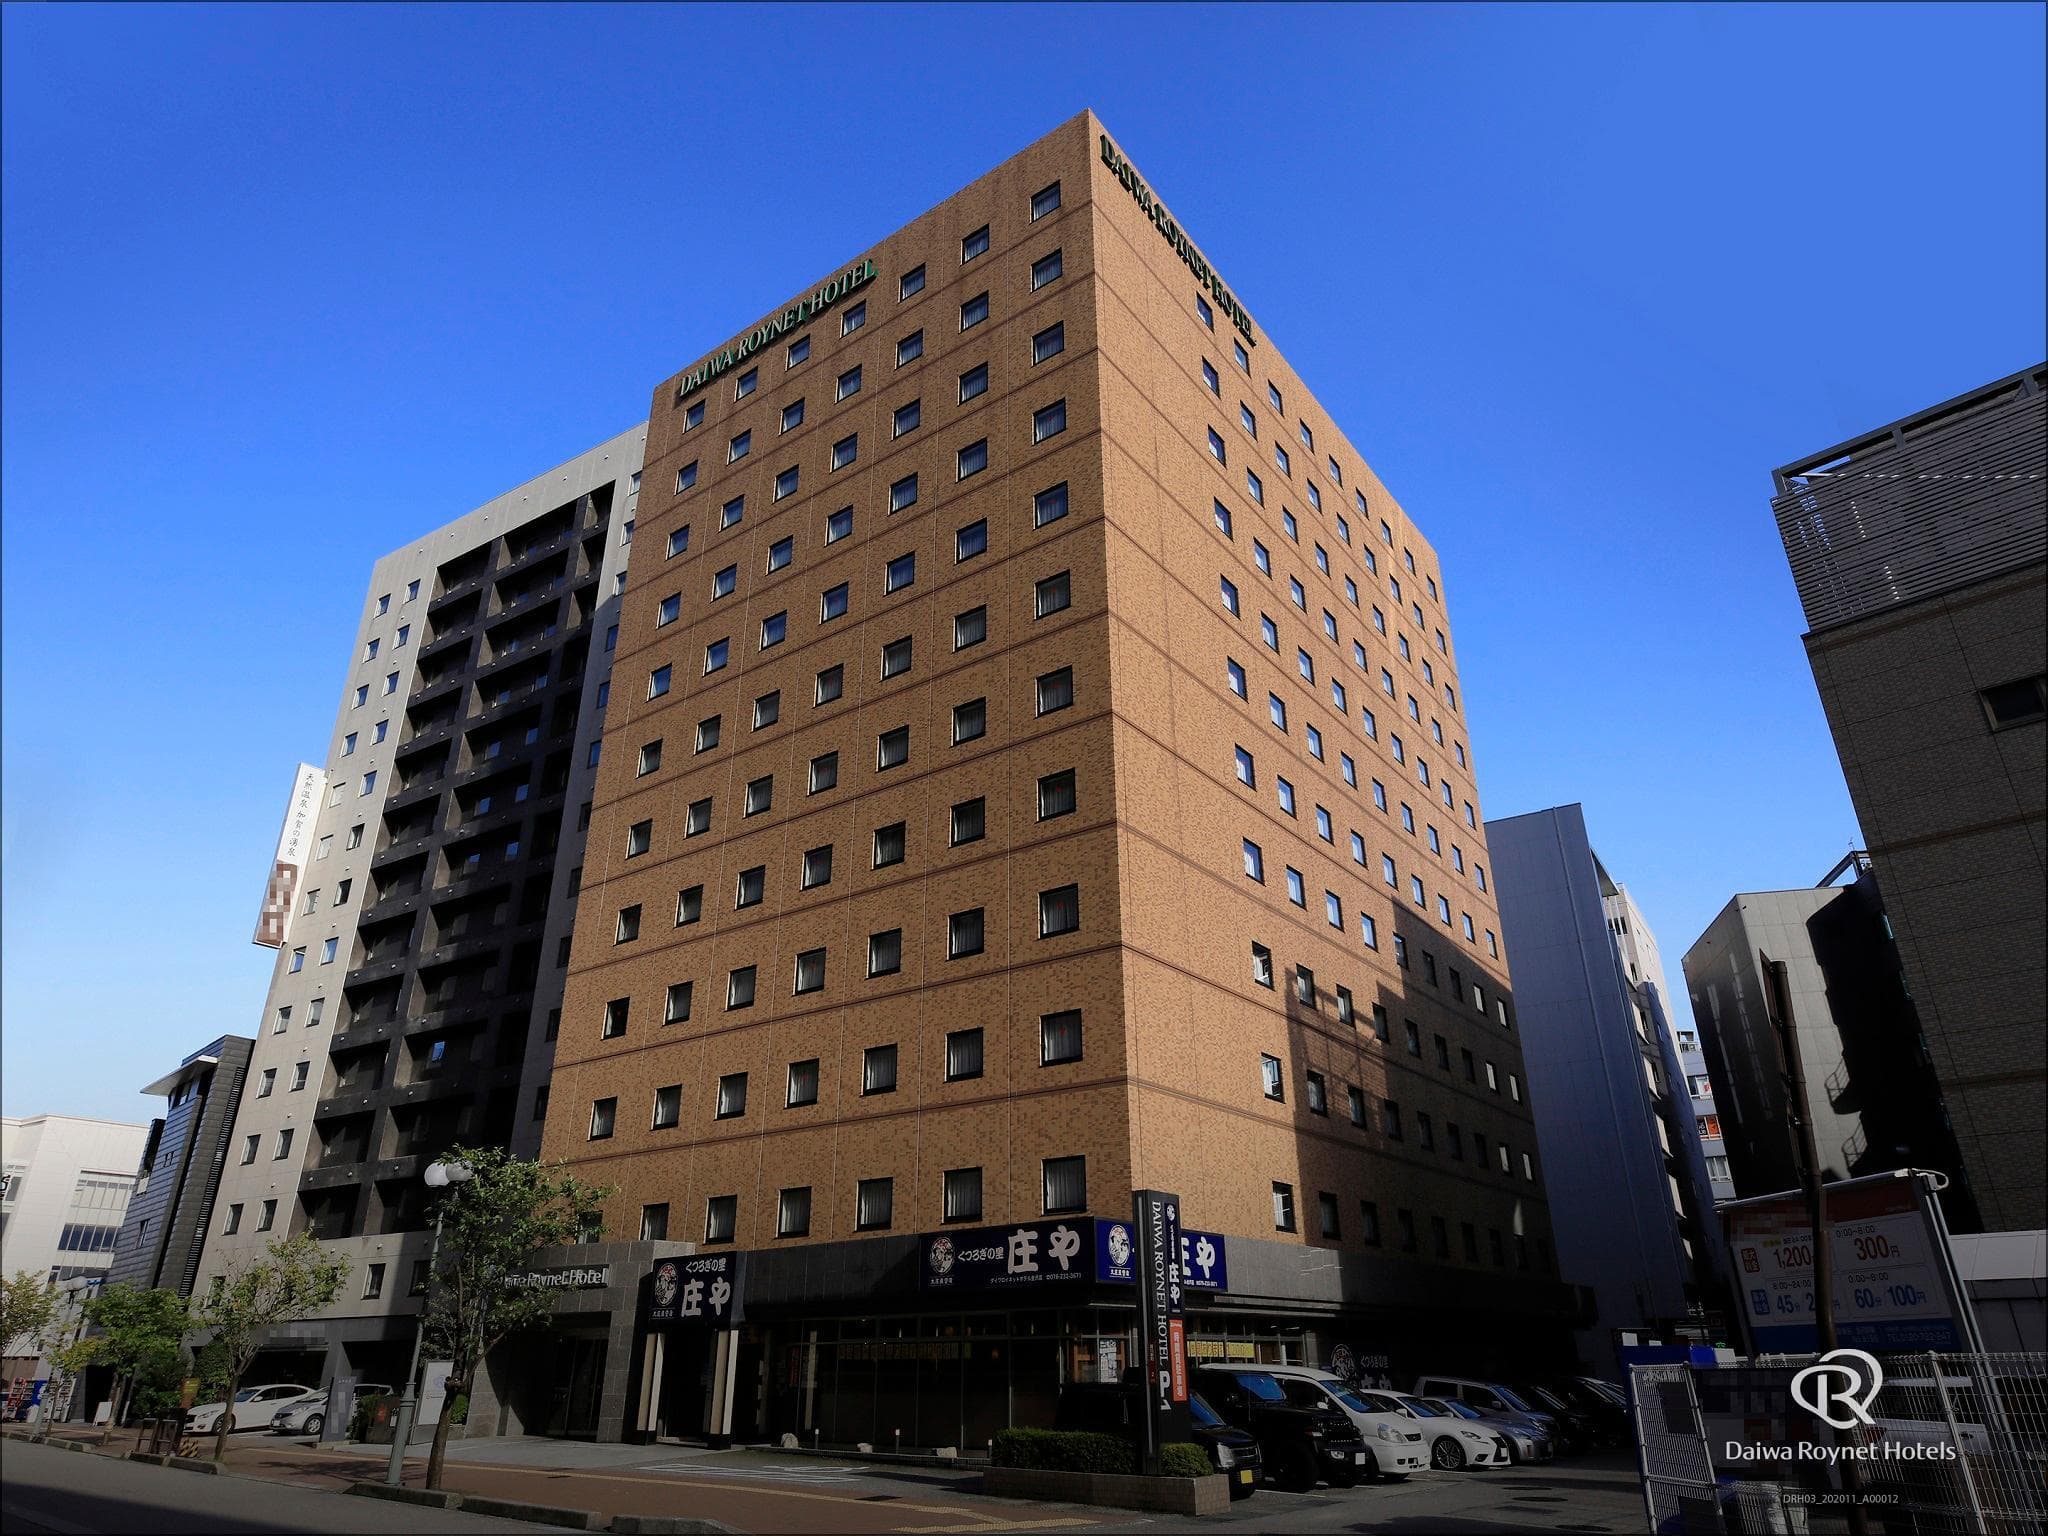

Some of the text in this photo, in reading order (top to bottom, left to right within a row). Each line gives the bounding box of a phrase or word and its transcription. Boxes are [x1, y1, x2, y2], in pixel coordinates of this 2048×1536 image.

[1100, 135, 1257, 347] DAIWA ROYNET HOTEL
[680, 259, 878, 397] DAIWA ROYNET HOTEL
[685, 1257, 727, 1273] くつろぎの里
[958, 1225, 1081, 1274] くつろぎの里 庄や
[681, 1276, 731, 1318] 庄や
[1152, 1201, 1168, 1366] DAIWA ROYNET HOTEL
[1160, 1371, 1171, 1397] P
